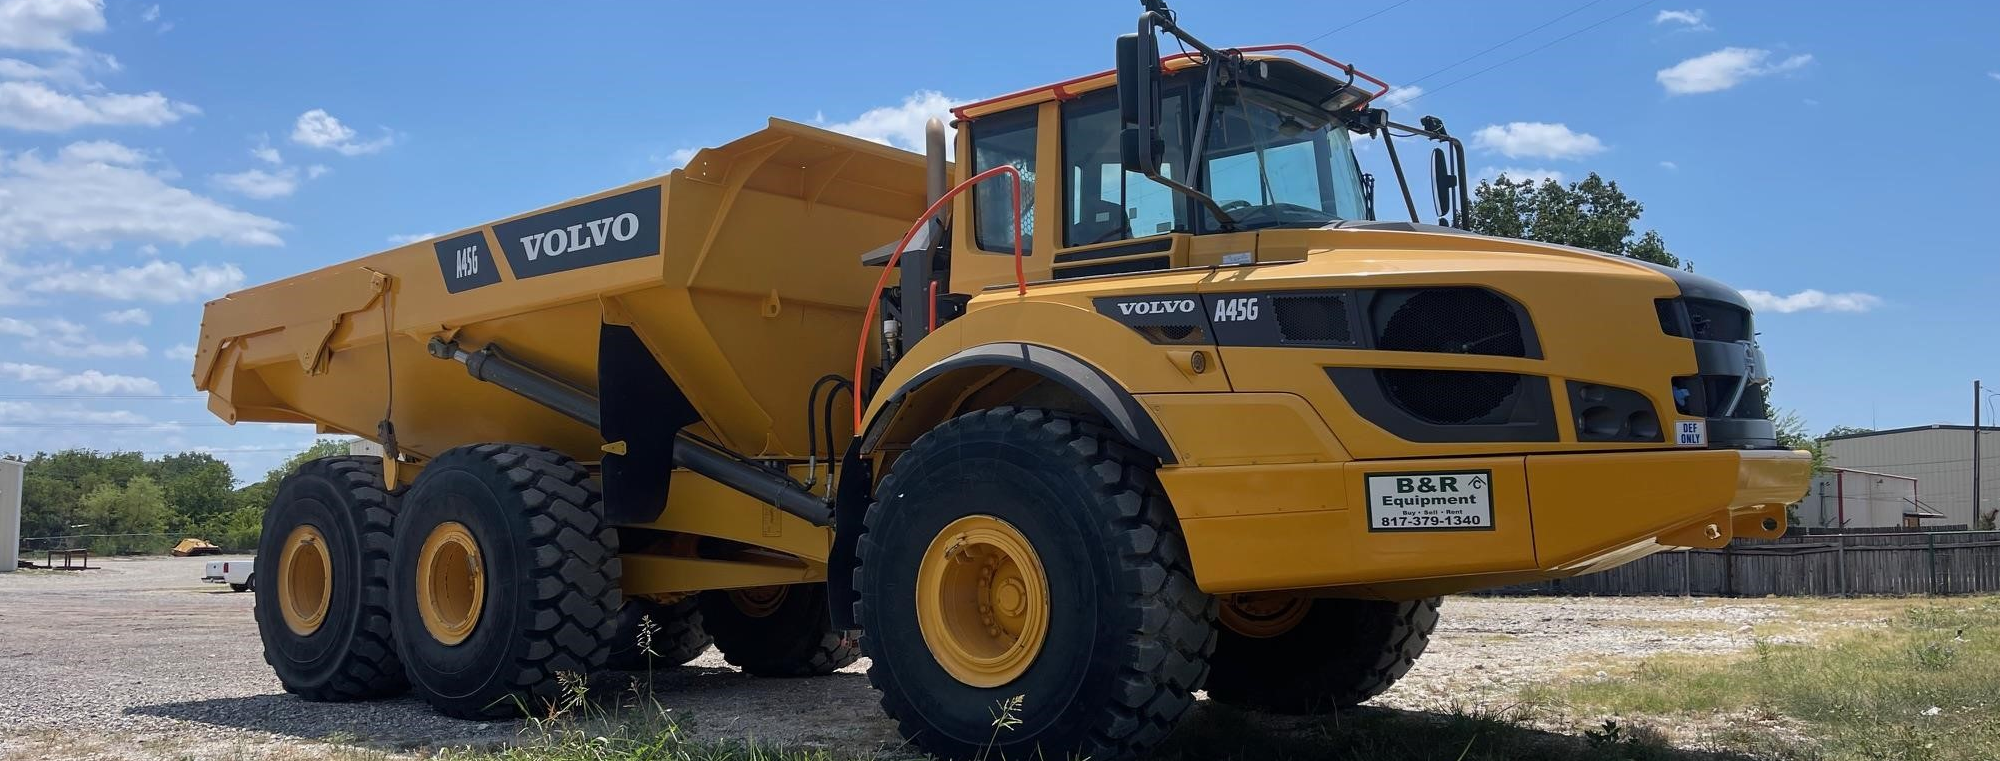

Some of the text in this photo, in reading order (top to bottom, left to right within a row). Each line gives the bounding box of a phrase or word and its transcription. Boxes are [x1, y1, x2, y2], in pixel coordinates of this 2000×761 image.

[520, 212, 639, 261] VOLVO
[456, 245, 478, 279] A45G
[1117, 299, 1195, 315] VOLVO
[1214, 298, 1259, 322] A45G
[1682, 423, 1698, 433] DEF
[1681, 433, 1700, 444] ONLY
[1396, 476, 1459, 493] B&R
[1382, 494, 1477, 508] Equipment
[1381, 515, 1481, 527] 817-379-1340
